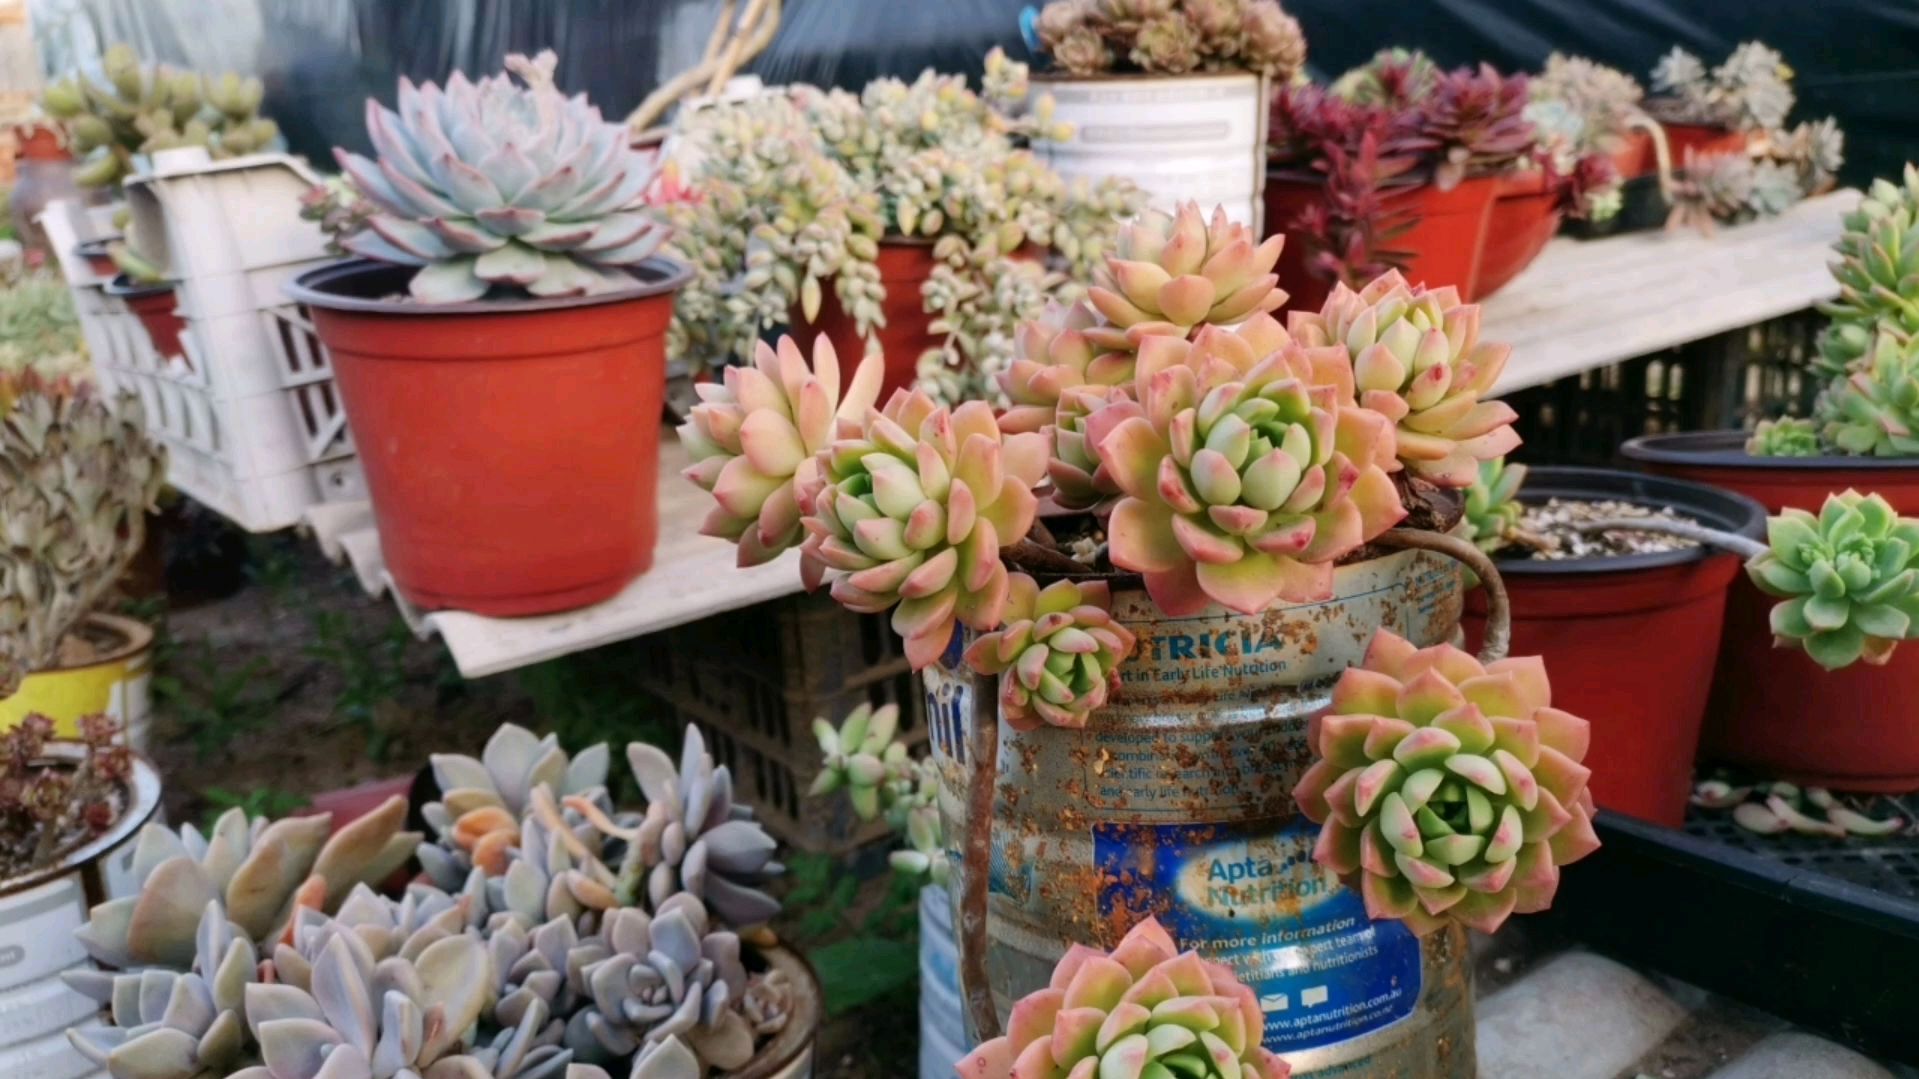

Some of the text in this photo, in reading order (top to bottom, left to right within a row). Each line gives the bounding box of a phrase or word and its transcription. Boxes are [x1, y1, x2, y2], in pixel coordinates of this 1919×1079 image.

[1125, 625, 1285, 661] UTRICIA
[1192, 664, 1219, 680] Life
[1223, 659, 1287, 678] Nutrition
[1208, 879, 1327, 907] Nutrition
[1180, 917, 1356, 949] For more information
[1287, 960, 1310, 976] and
[1313, 945, 1378, 971] nutritionists
